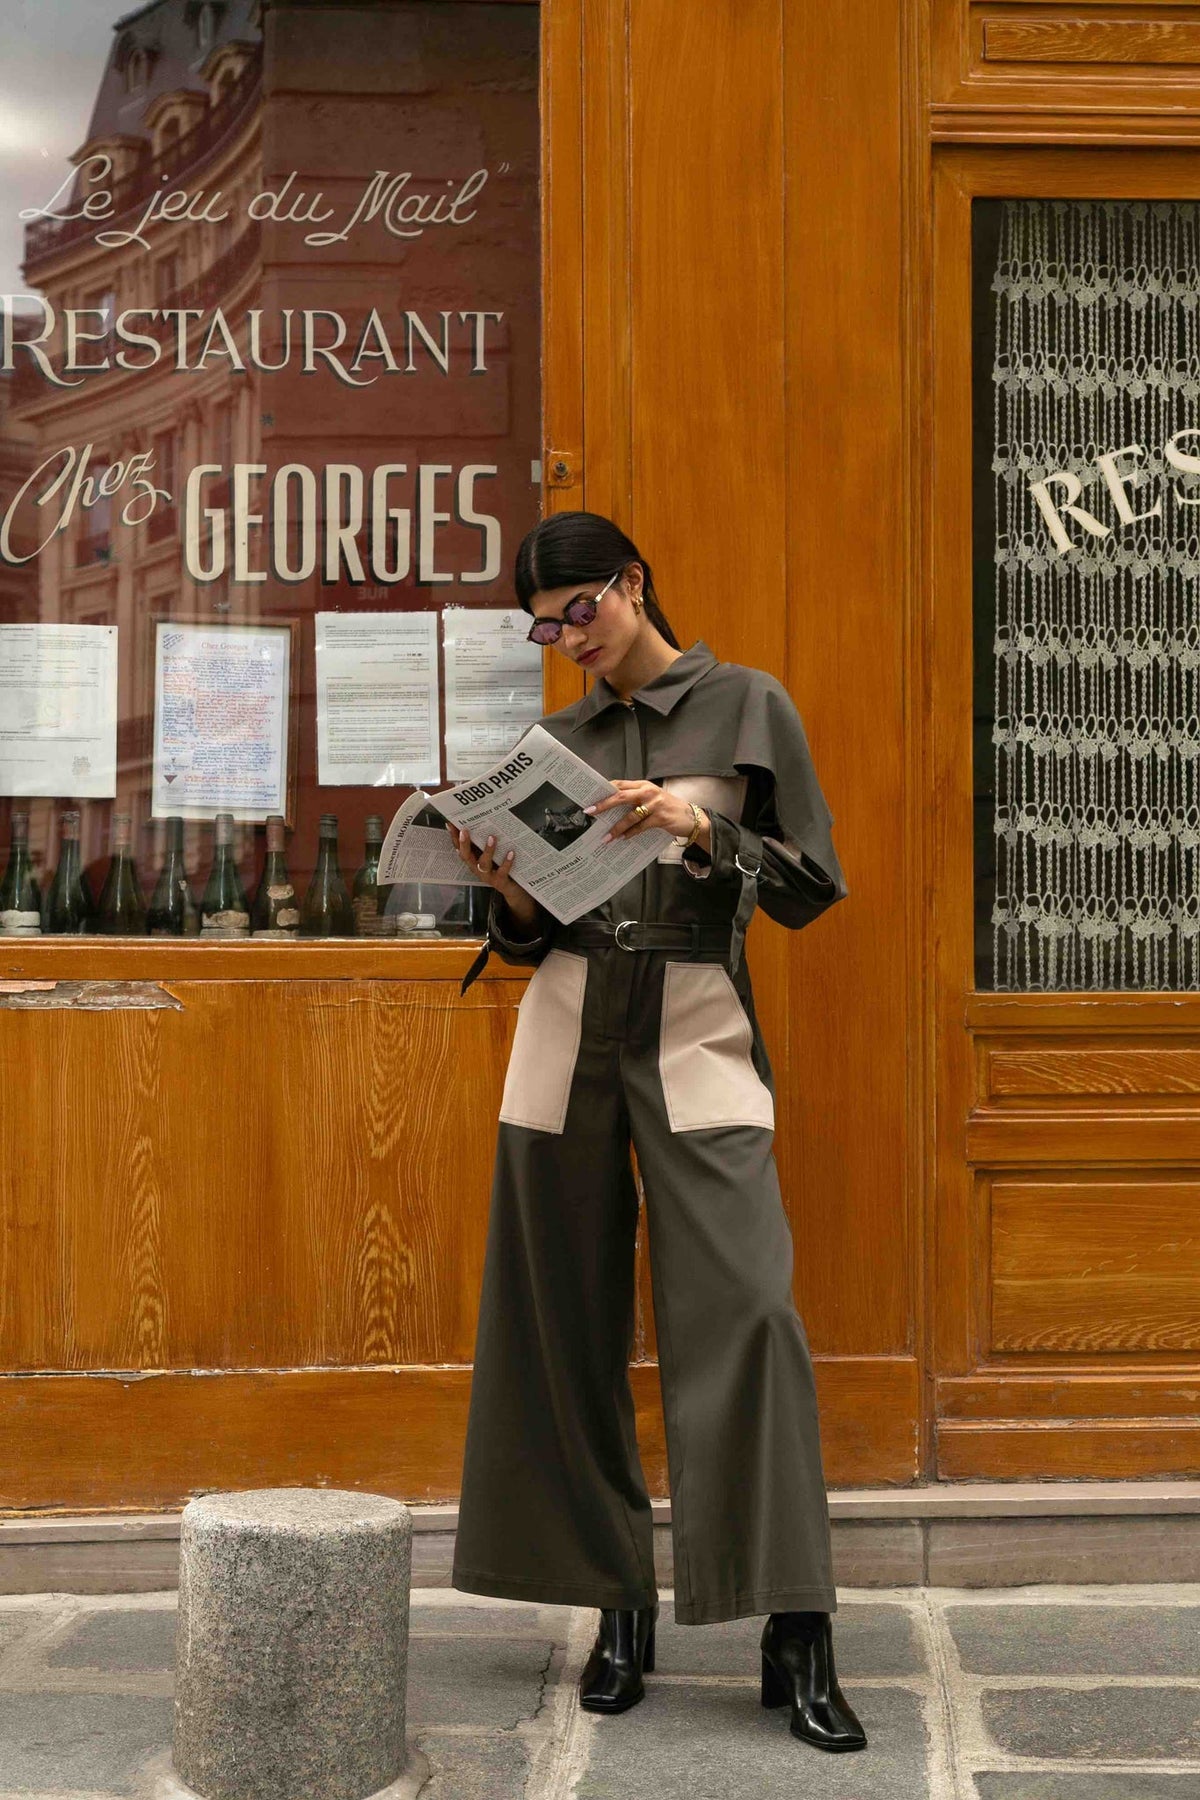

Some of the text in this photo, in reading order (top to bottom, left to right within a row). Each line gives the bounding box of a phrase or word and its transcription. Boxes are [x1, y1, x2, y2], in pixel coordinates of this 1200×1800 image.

[94, 173, 229, 250] jeu
[248, 171, 335, 223] du
[0, 293, 504, 387] RESTAURANT
[1, 443, 502, 583] Chez GEORGES
[453, 782, 494, 806] BOBO
[488, 751, 534, 789] PARIS
[397, 815, 413, 838] BOBO
[466, 808, 493, 822] summer
[528, 875, 547, 887] Dans
